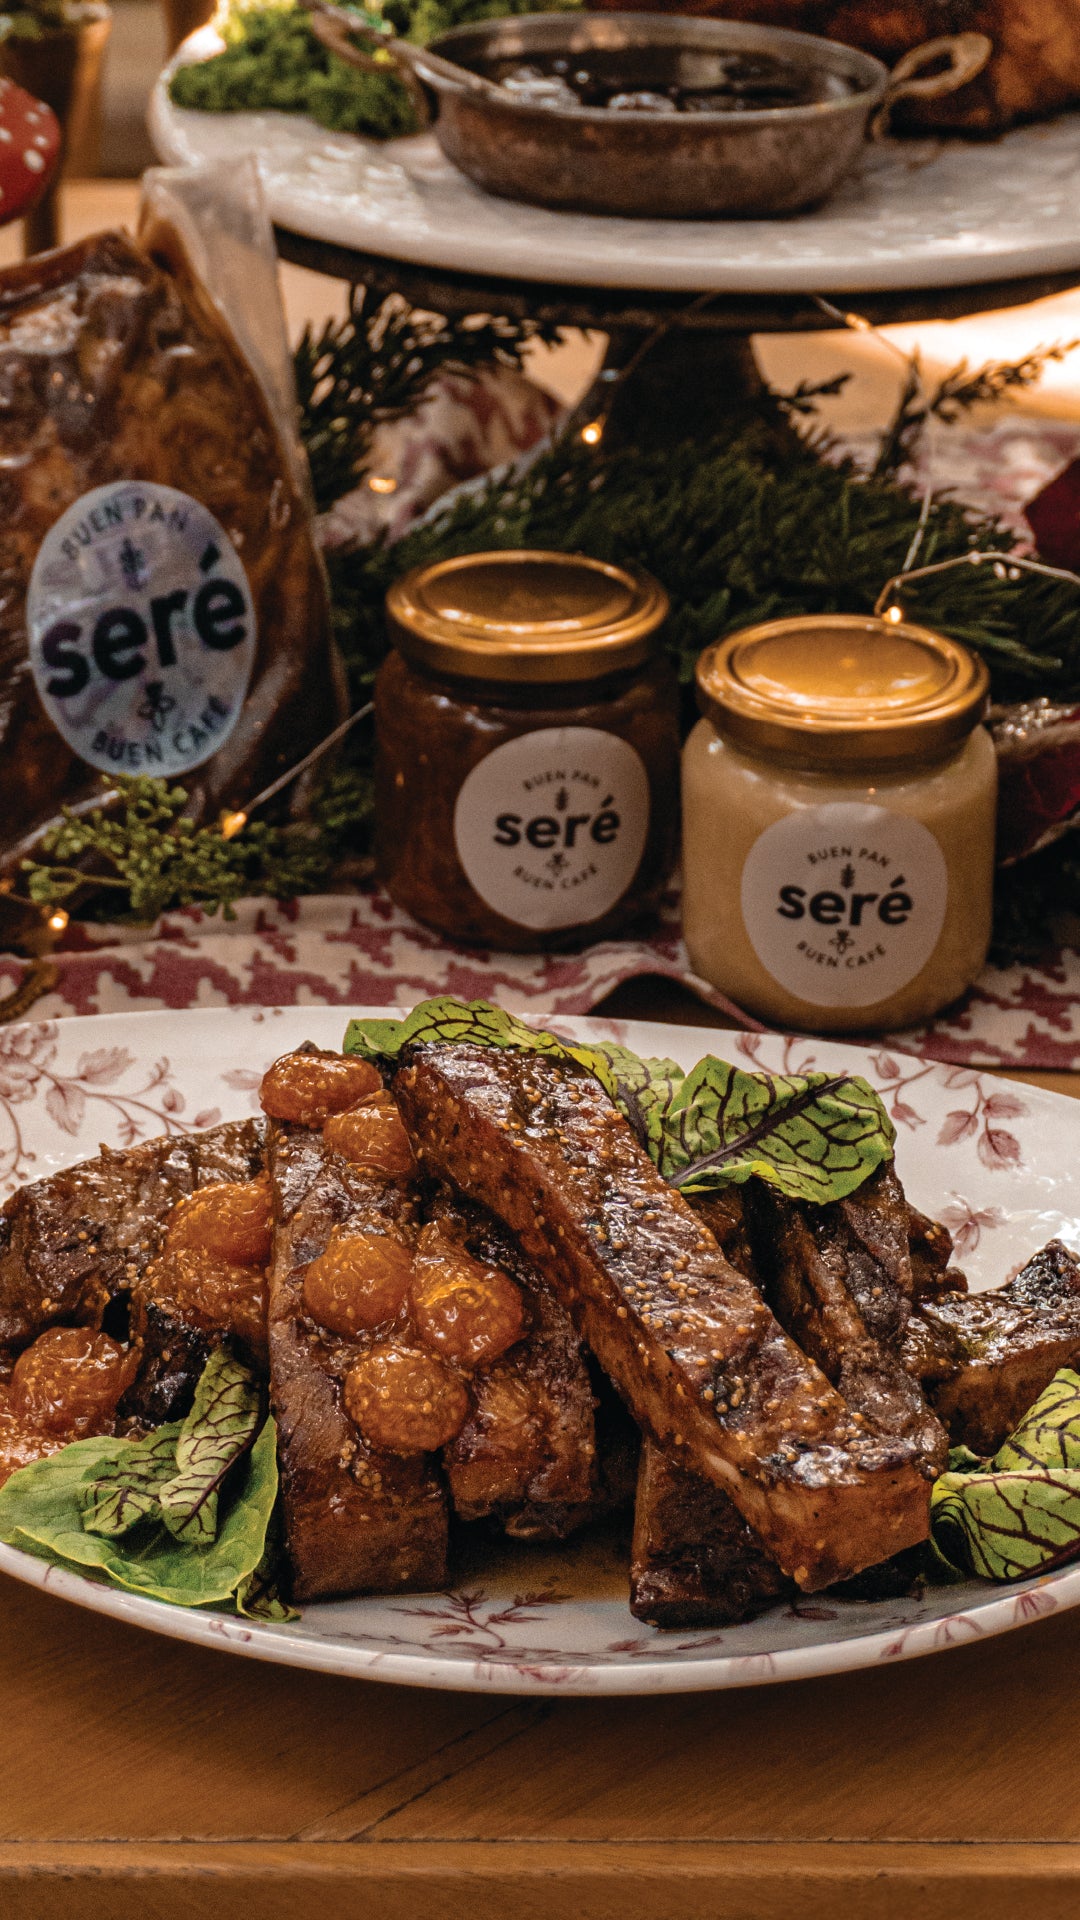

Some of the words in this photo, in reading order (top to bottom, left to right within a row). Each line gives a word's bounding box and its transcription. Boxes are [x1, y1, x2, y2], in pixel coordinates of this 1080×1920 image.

[61, 498, 124, 561] BUEN
[131, 498, 190, 532] PAN
[40, 541, 246, 698] seré
[91, 729, 166, 768] BUEN
[523, 769, 567, 791] BUEN
[571, 769, 600, 789] PAN
[494, 794, 621, 849] seré
[807, 846, 853, 865] BUEN
[858, 847, 890, 868] PAN
[514, 865, 555, 890] BUEN
[777, 873, 914, 926] seré
[797, 940, 839, 968] BUEN
